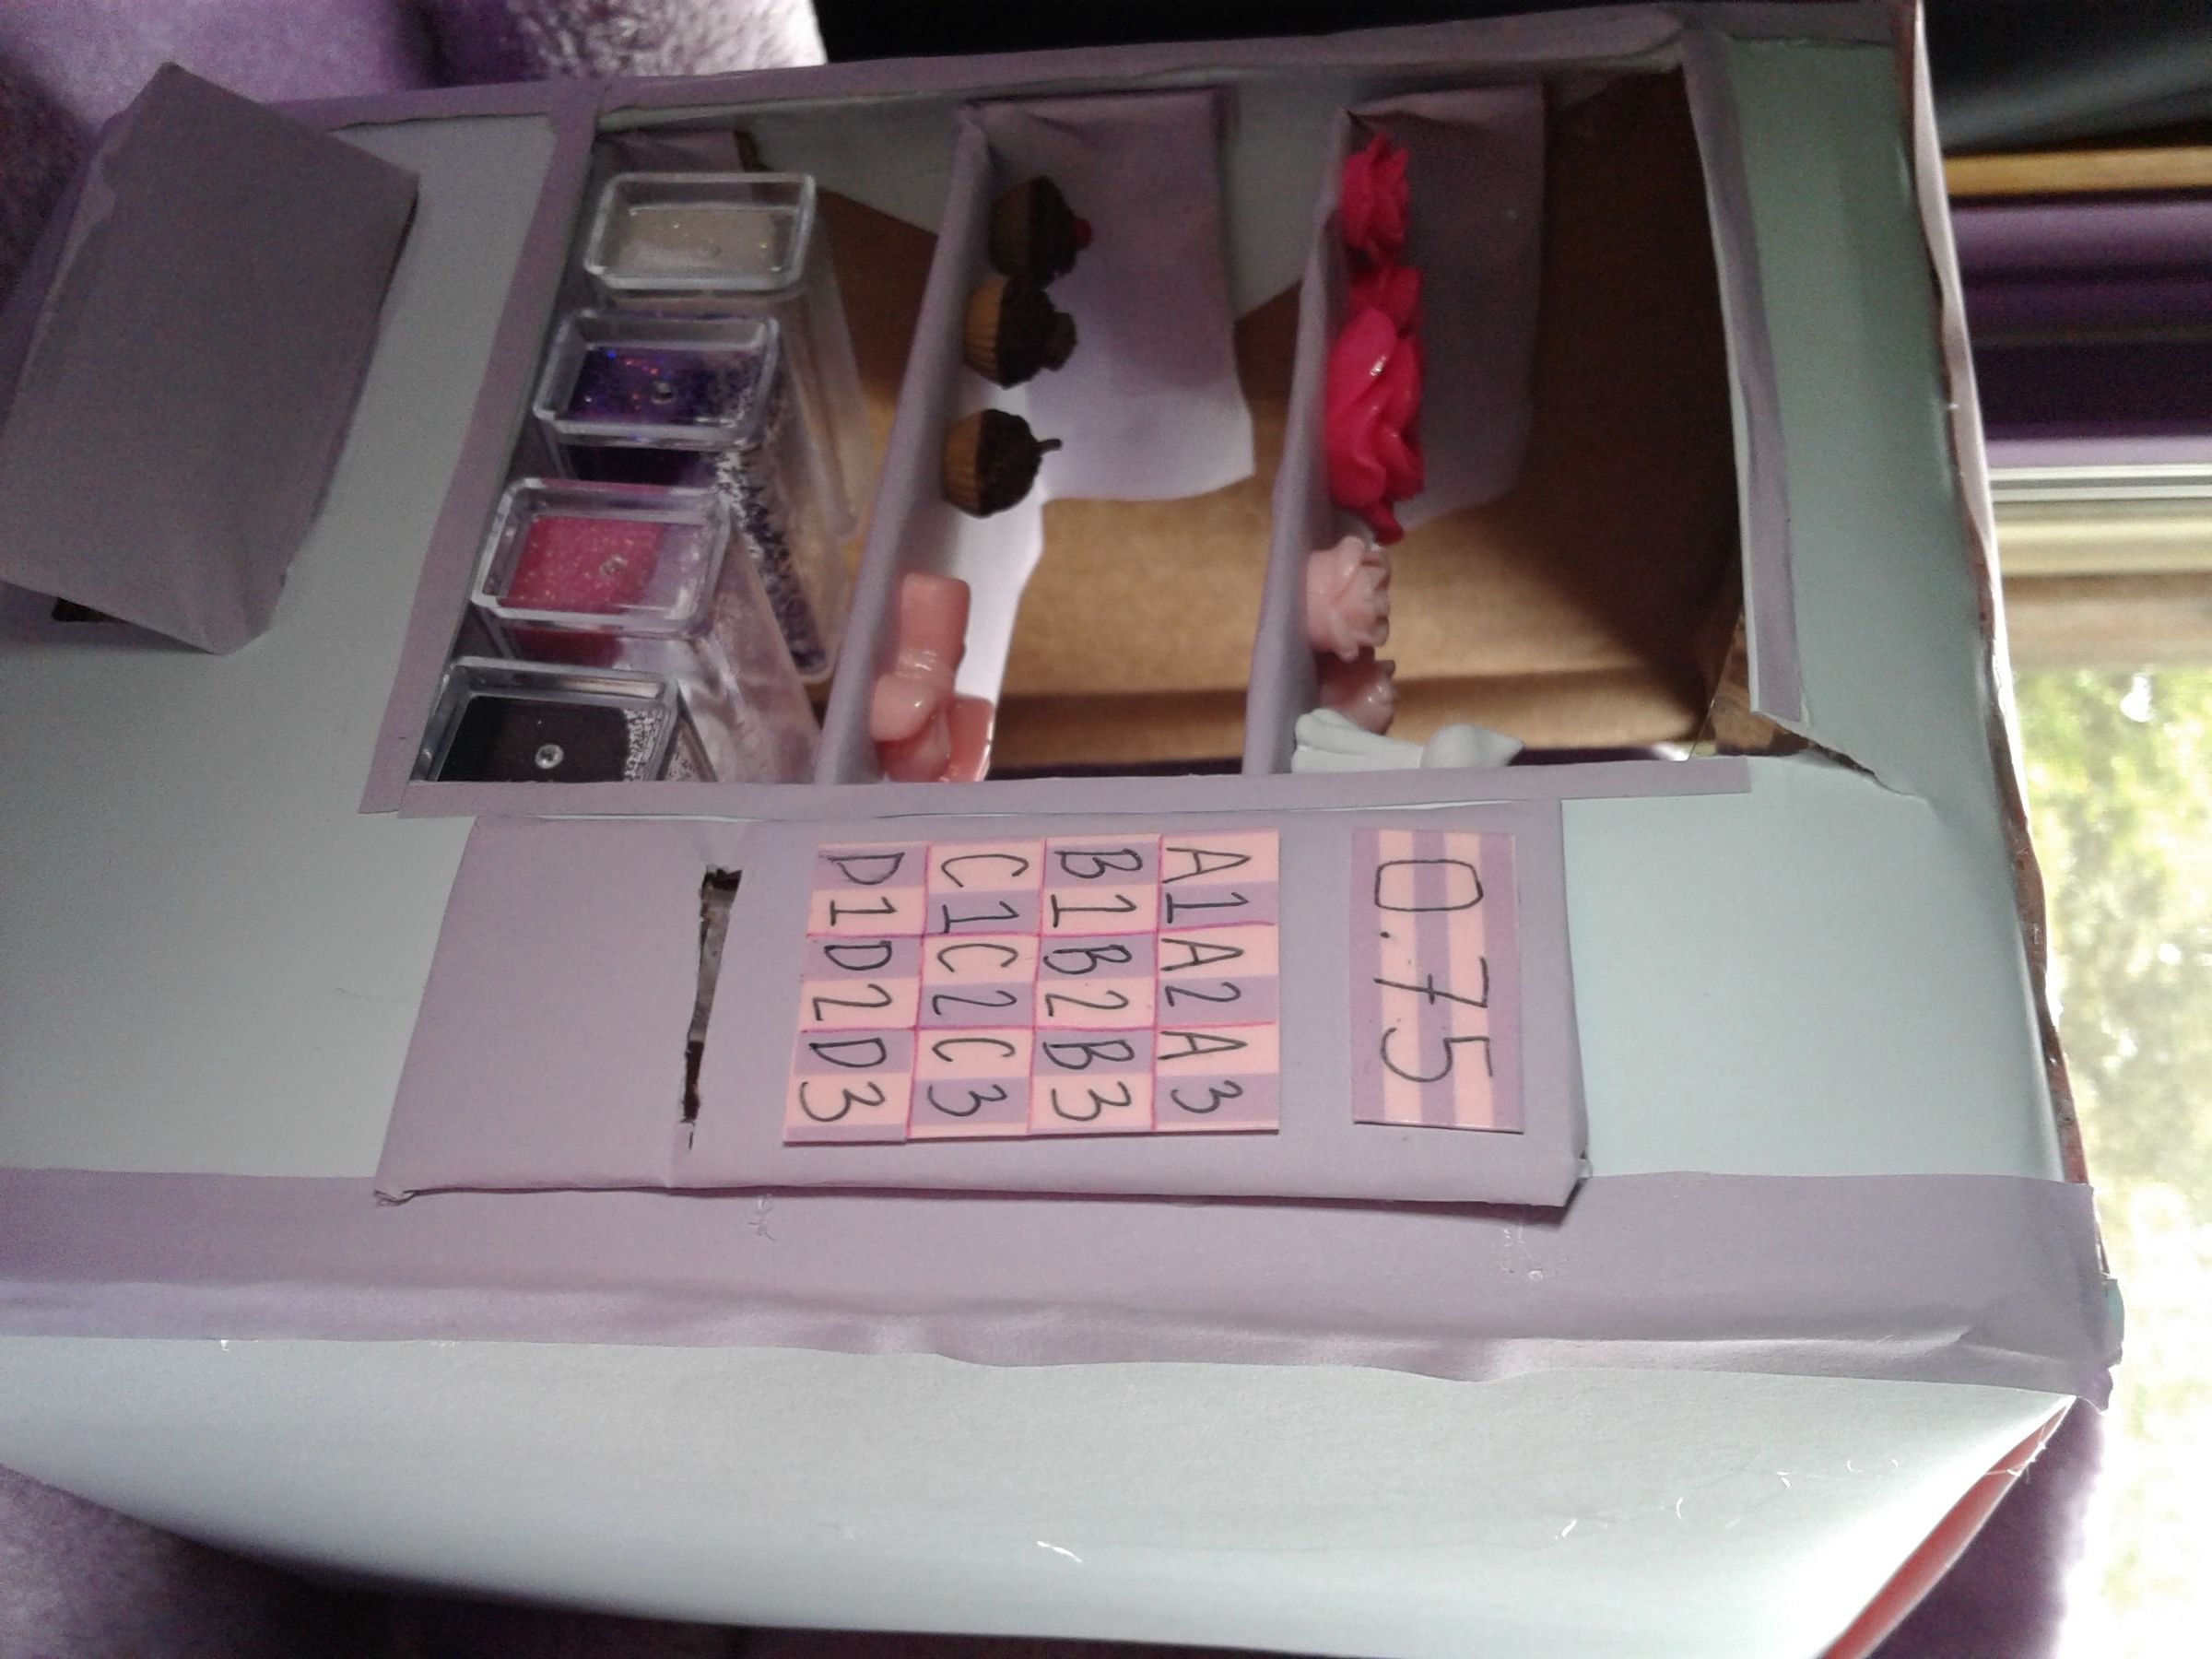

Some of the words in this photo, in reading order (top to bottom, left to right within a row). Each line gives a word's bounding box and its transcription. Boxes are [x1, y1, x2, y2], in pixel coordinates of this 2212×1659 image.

[818, 850, 906, 925] D1
[940, 853, 1030, 934] C1
[1050, 848, 1144, 927] B1
[1161, 846, 1252, 925] A1
[811, 940, 893, 1020] D2
[932, 943, 1018, 1016] C2
[1042, 945, 1133, 1017] B2
[1159, 938, 1245, 1007] A2
[1374, 858, 1494, 1084] 0.75
[799, 1037, 888, 1122] D3
[926, 1036, 1016, 1118] C3
[1042, 1039, 1135, 1122] B3
[1159, 1030, 1248, 1114] A3
